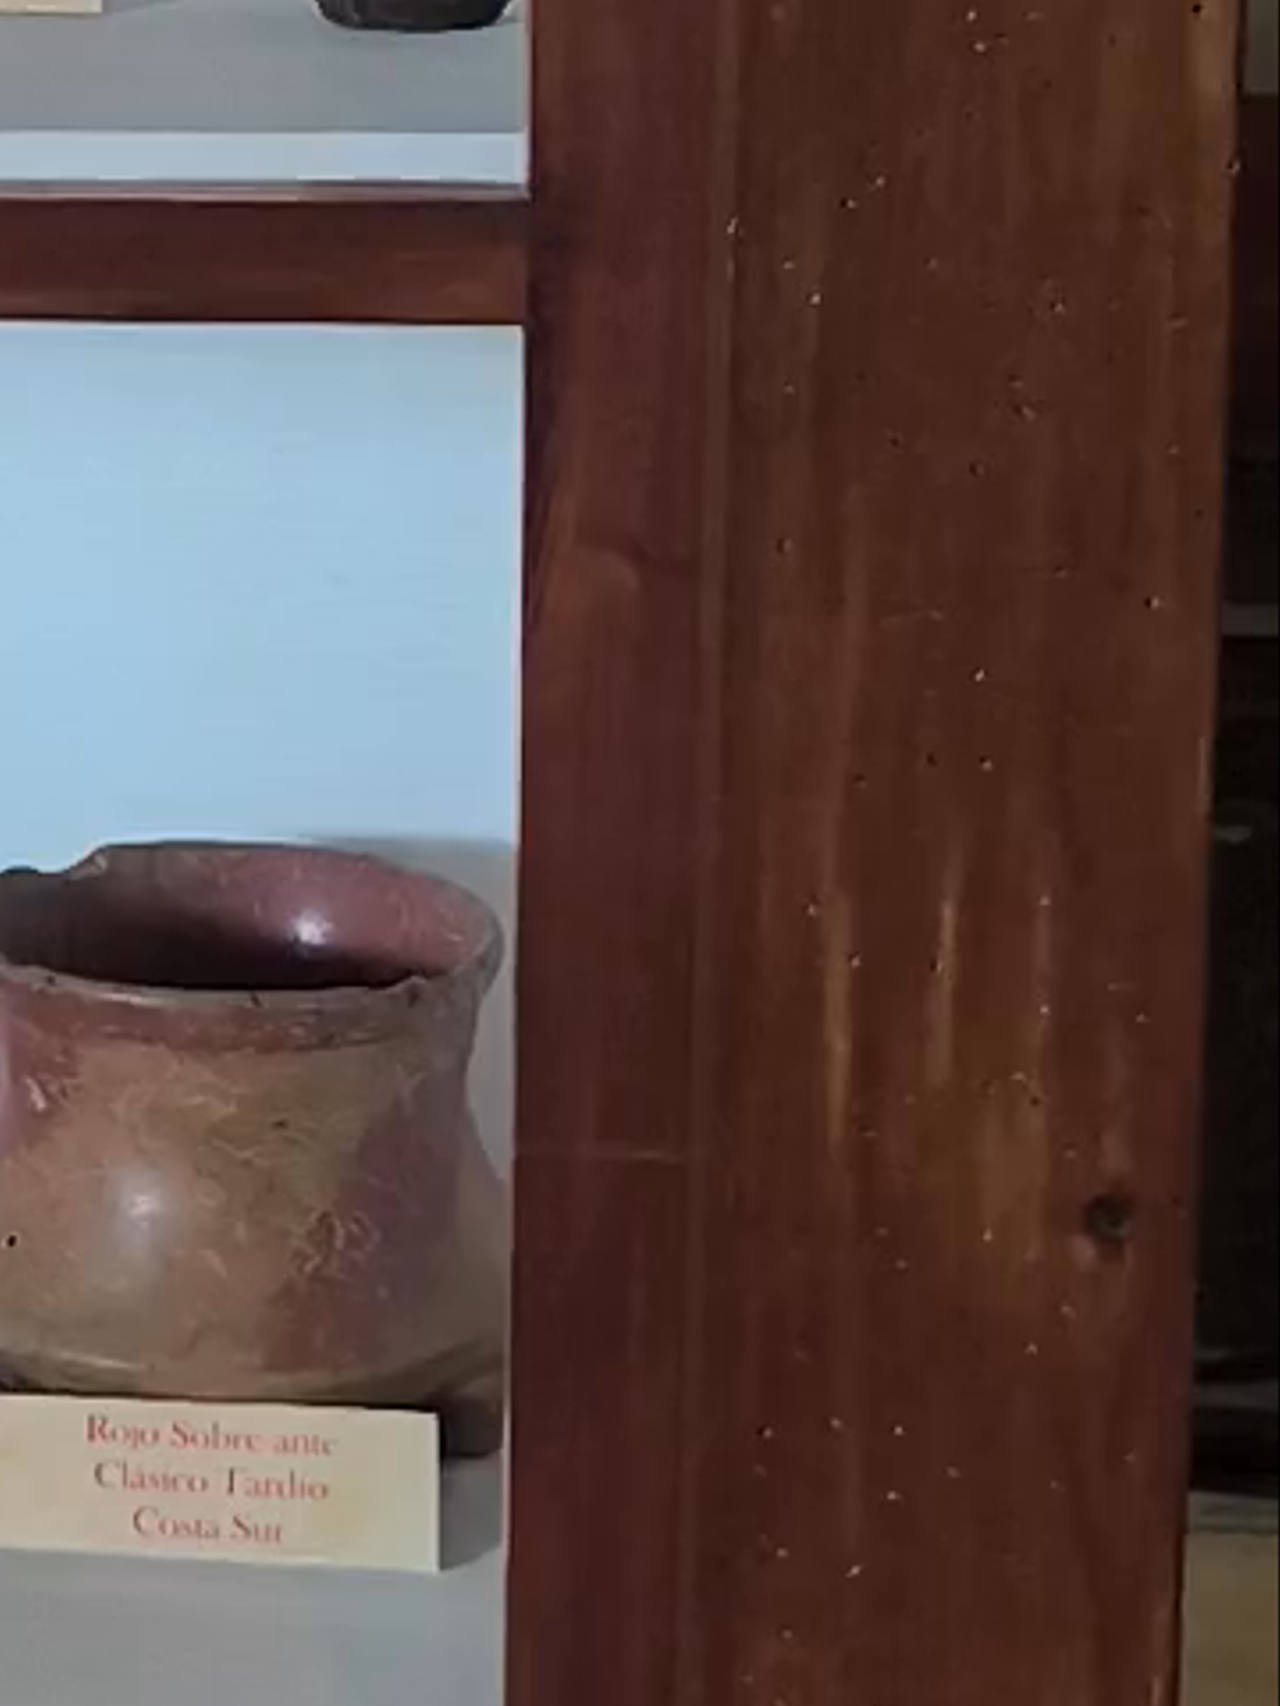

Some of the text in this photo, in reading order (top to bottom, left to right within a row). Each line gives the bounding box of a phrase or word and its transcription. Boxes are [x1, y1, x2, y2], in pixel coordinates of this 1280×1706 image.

[86, 1413, 160, 1450] Rojo
[170, 1420, 262, 1451] Sobre
[132, 1506, 282, 1543] Costa Sur
